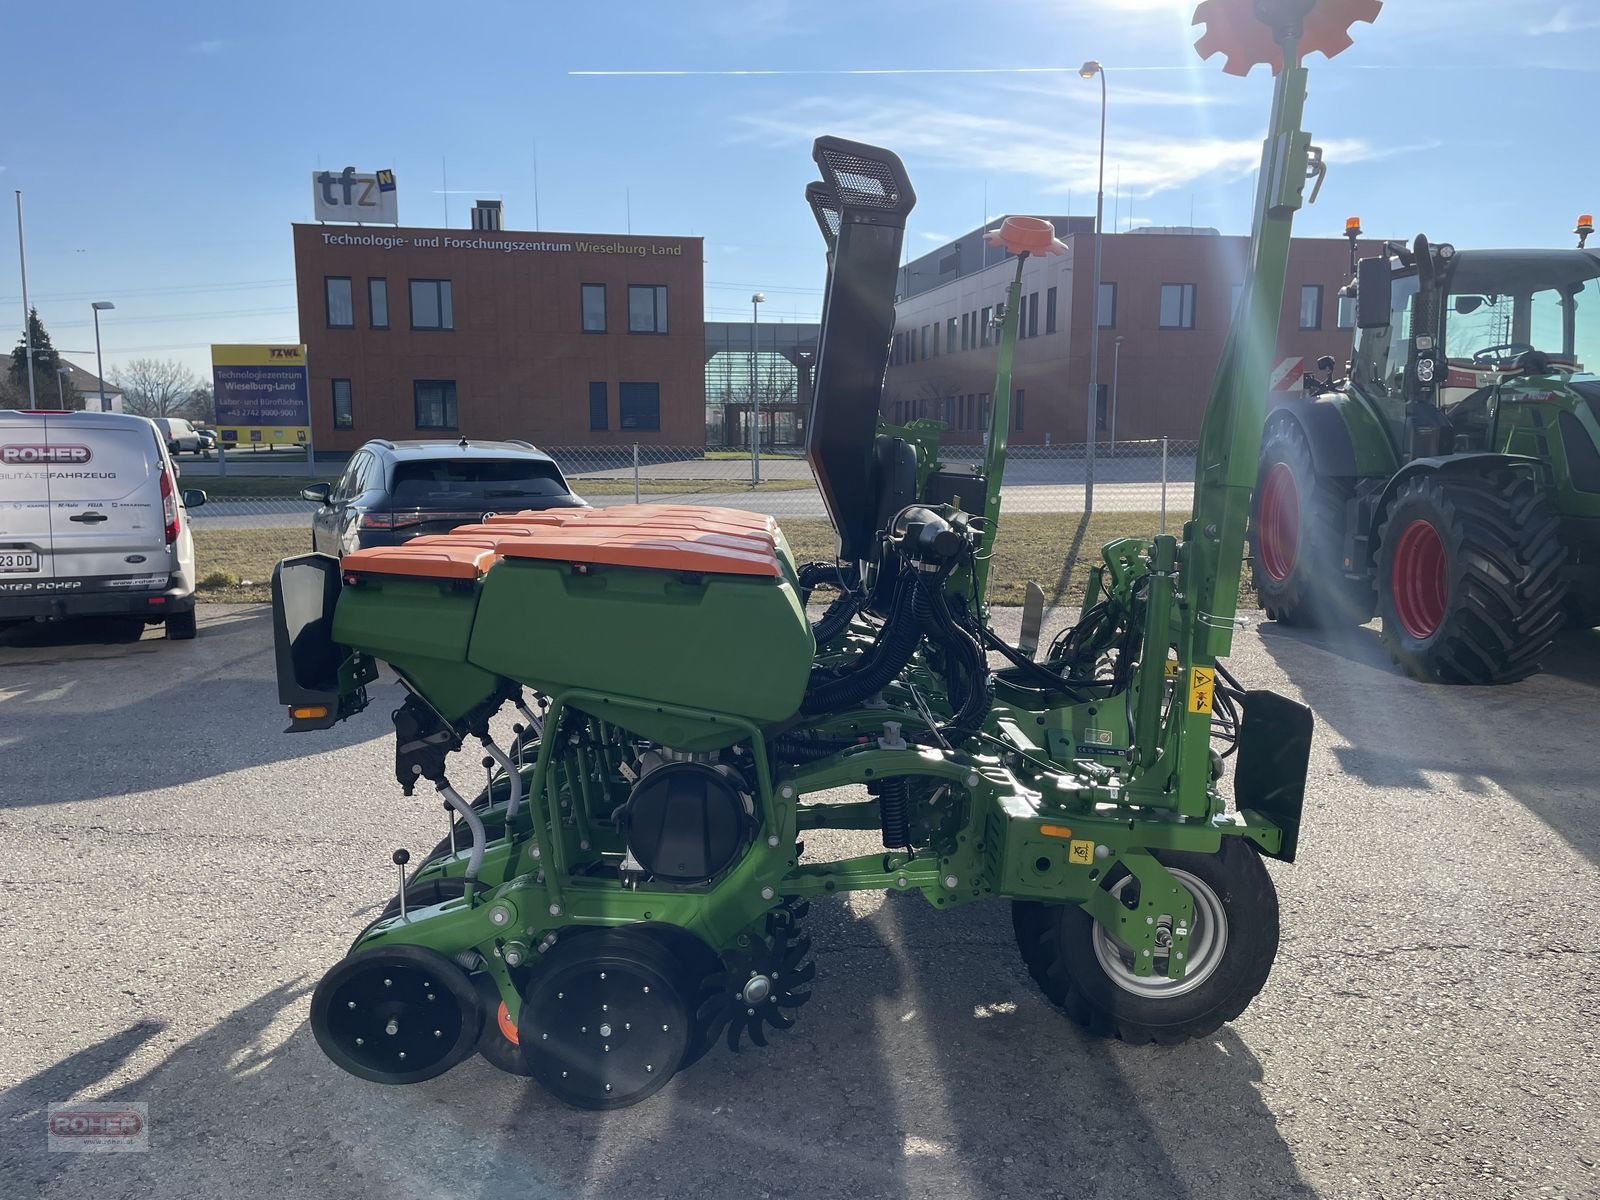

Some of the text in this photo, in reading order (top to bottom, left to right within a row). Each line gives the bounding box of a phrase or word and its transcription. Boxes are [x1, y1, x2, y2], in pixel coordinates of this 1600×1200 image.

[321, 232, 682, 256] Technologie- und Forschungszentrum Wieselburg-Land
[218, 371, 302, 381] Technologiezentrum
[225, 383, 296, 392] Wieselburg-Land
[244, 398, 260, 406] und
[3, 447, 87, 462] ROHER
[17, 555, 32, 567] DD
[36, 581, 82, 590] ROHER
